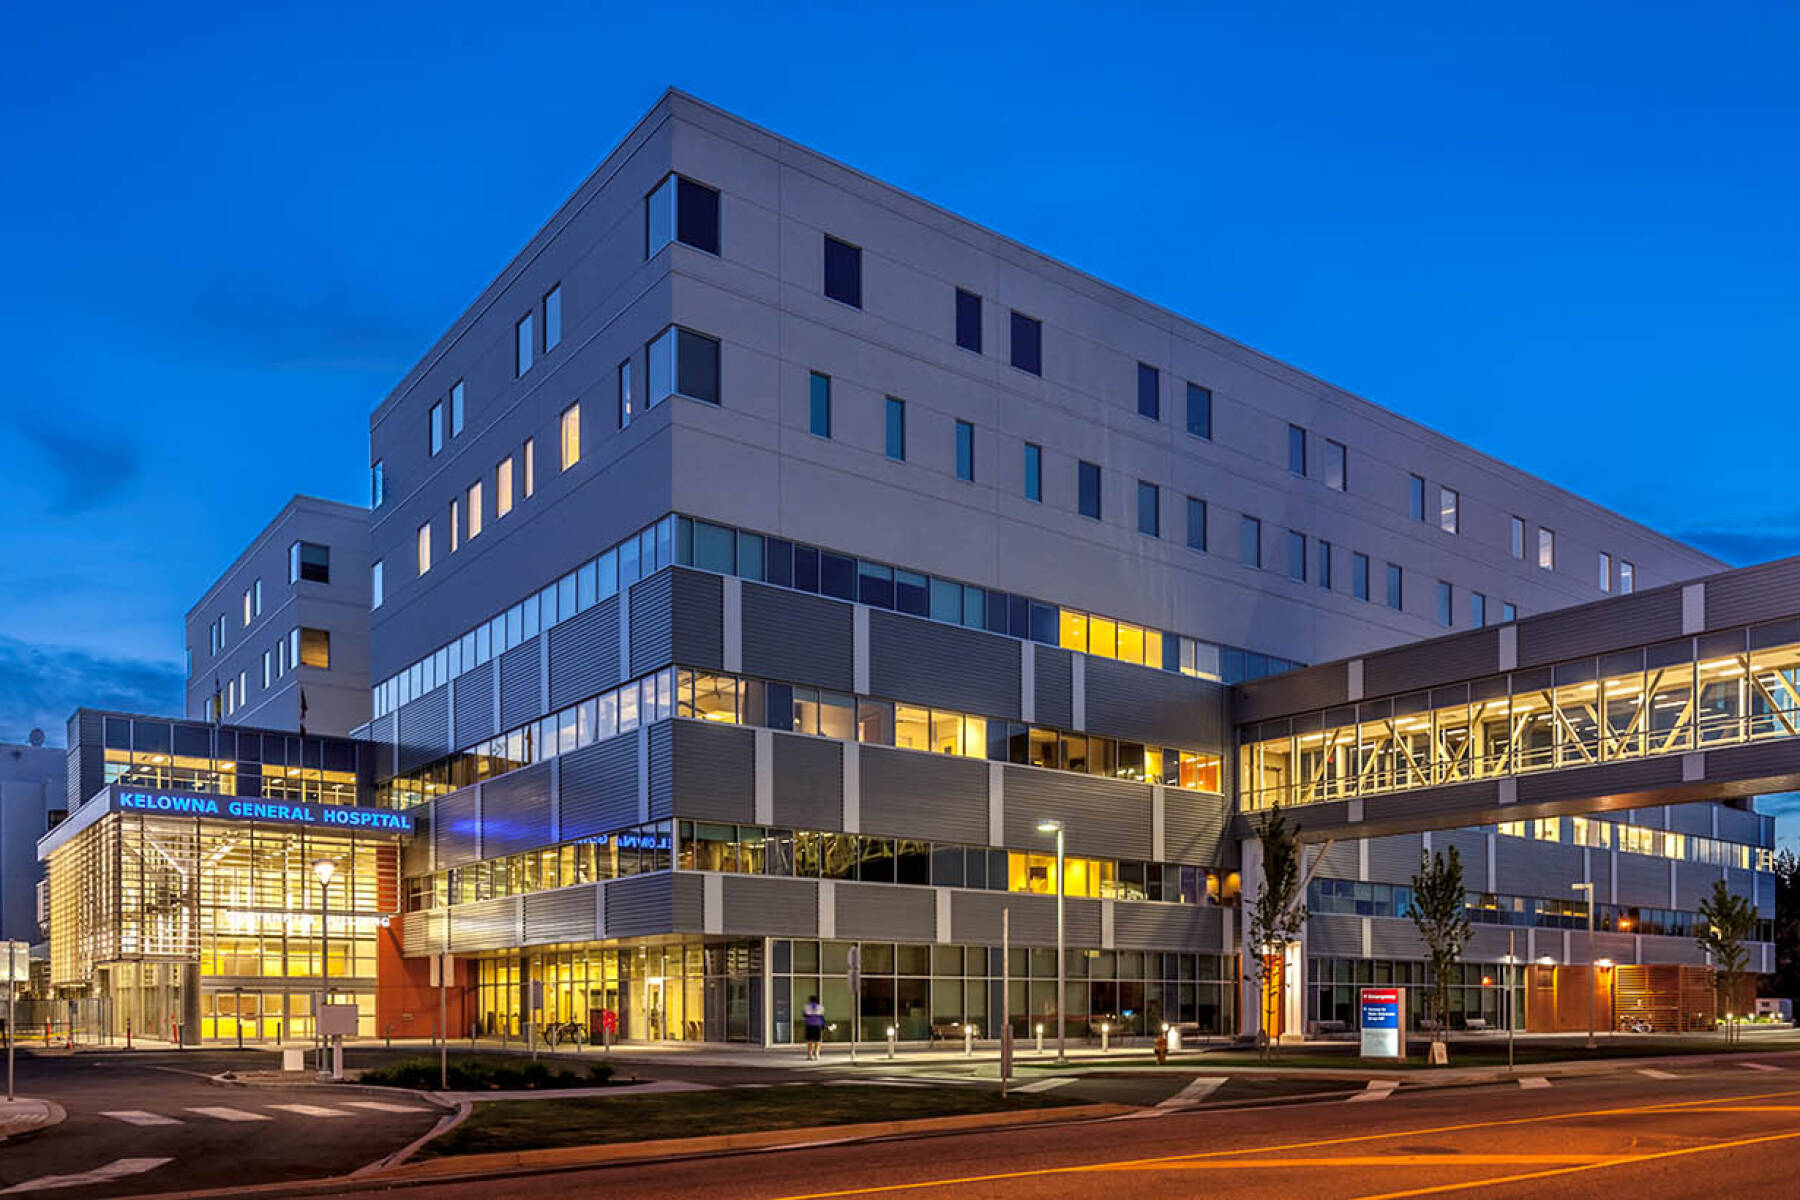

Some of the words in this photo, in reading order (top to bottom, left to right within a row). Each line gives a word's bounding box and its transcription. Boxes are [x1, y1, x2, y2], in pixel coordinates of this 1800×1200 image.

[119, 792, 219, 814] KELOWNA
[228, 801, 314, 822] GENERAL
[323, 809, 411, 829] HOSPITAL
